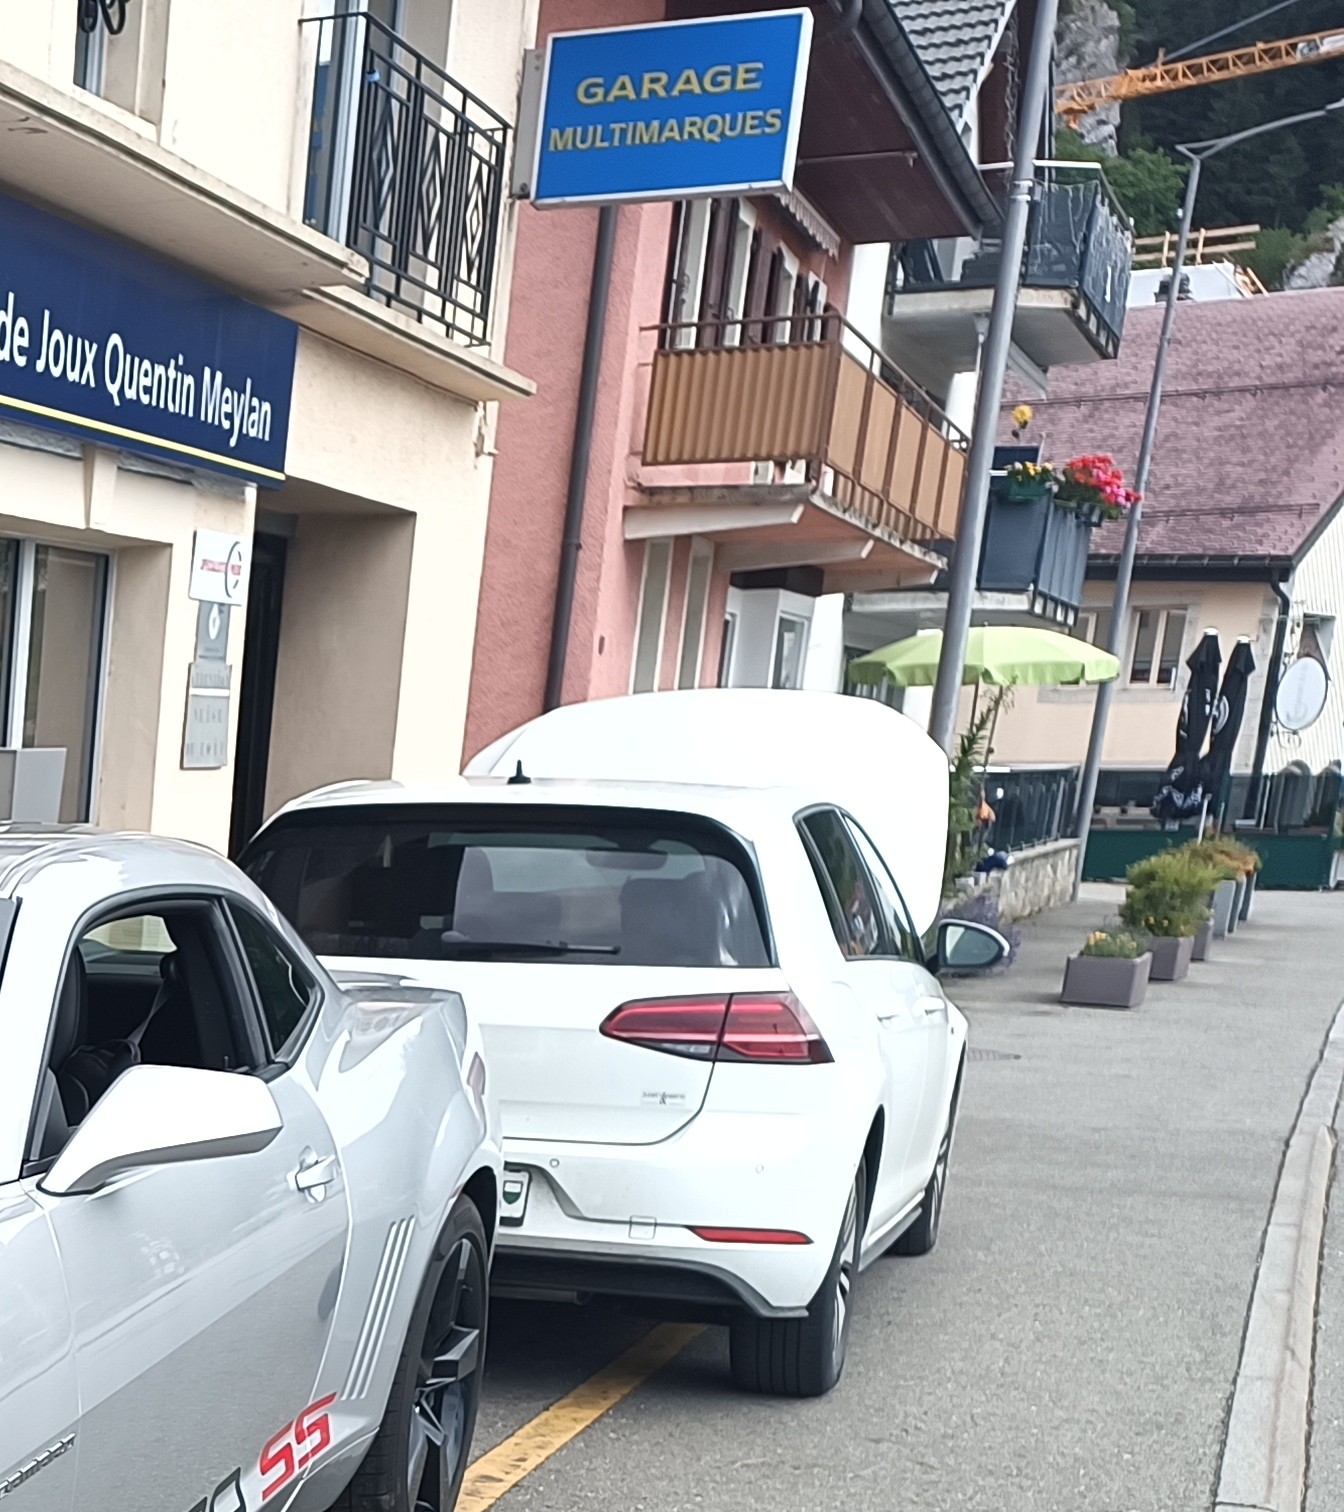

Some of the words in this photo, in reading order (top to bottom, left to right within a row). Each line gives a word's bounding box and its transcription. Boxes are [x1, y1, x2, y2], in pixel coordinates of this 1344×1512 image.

[577, 62, 765, 105] GARAGE
[549, 108, 784, 152] MULTIMARQUES
[35, 309, 98, 388] Joux
[104, 333, 195, 418] Quentin
[200, 366, 272, 448] Meylan
[258, 1391, 338, 1502] SS
